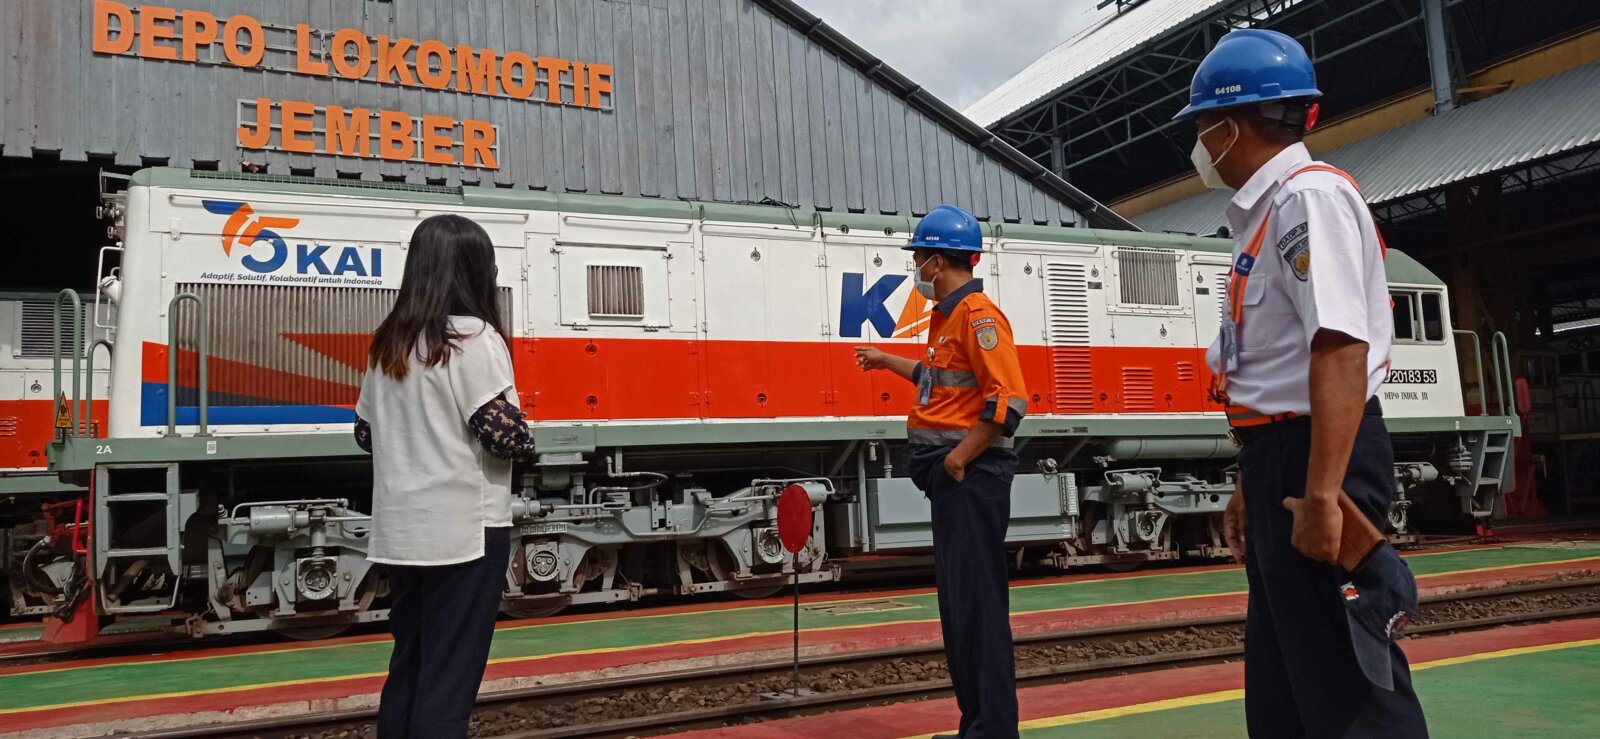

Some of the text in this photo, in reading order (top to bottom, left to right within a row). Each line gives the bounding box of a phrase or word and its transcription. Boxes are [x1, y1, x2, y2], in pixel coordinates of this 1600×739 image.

[94, 0, 613, 108] DEPO LOKOMOTIF
[1215, 84, 1241, 95] 64108
[238, 98, 498, 169] JEMBER
[1280, 229, 1298, 248] DAOP
[296, 244, 382, 277] KAI
[200, 272, 235, 281] Adaptif,
[269, 274, 318, 284] Kolaboratif
[839, 272, 932, 338] KA
[1423, 370, 1436, 383] 53
[1384, 391, 1399, 400] DEPO
[1401, 392, 1418, 400] INDUK
[96, 445, 112, 455] 2A
